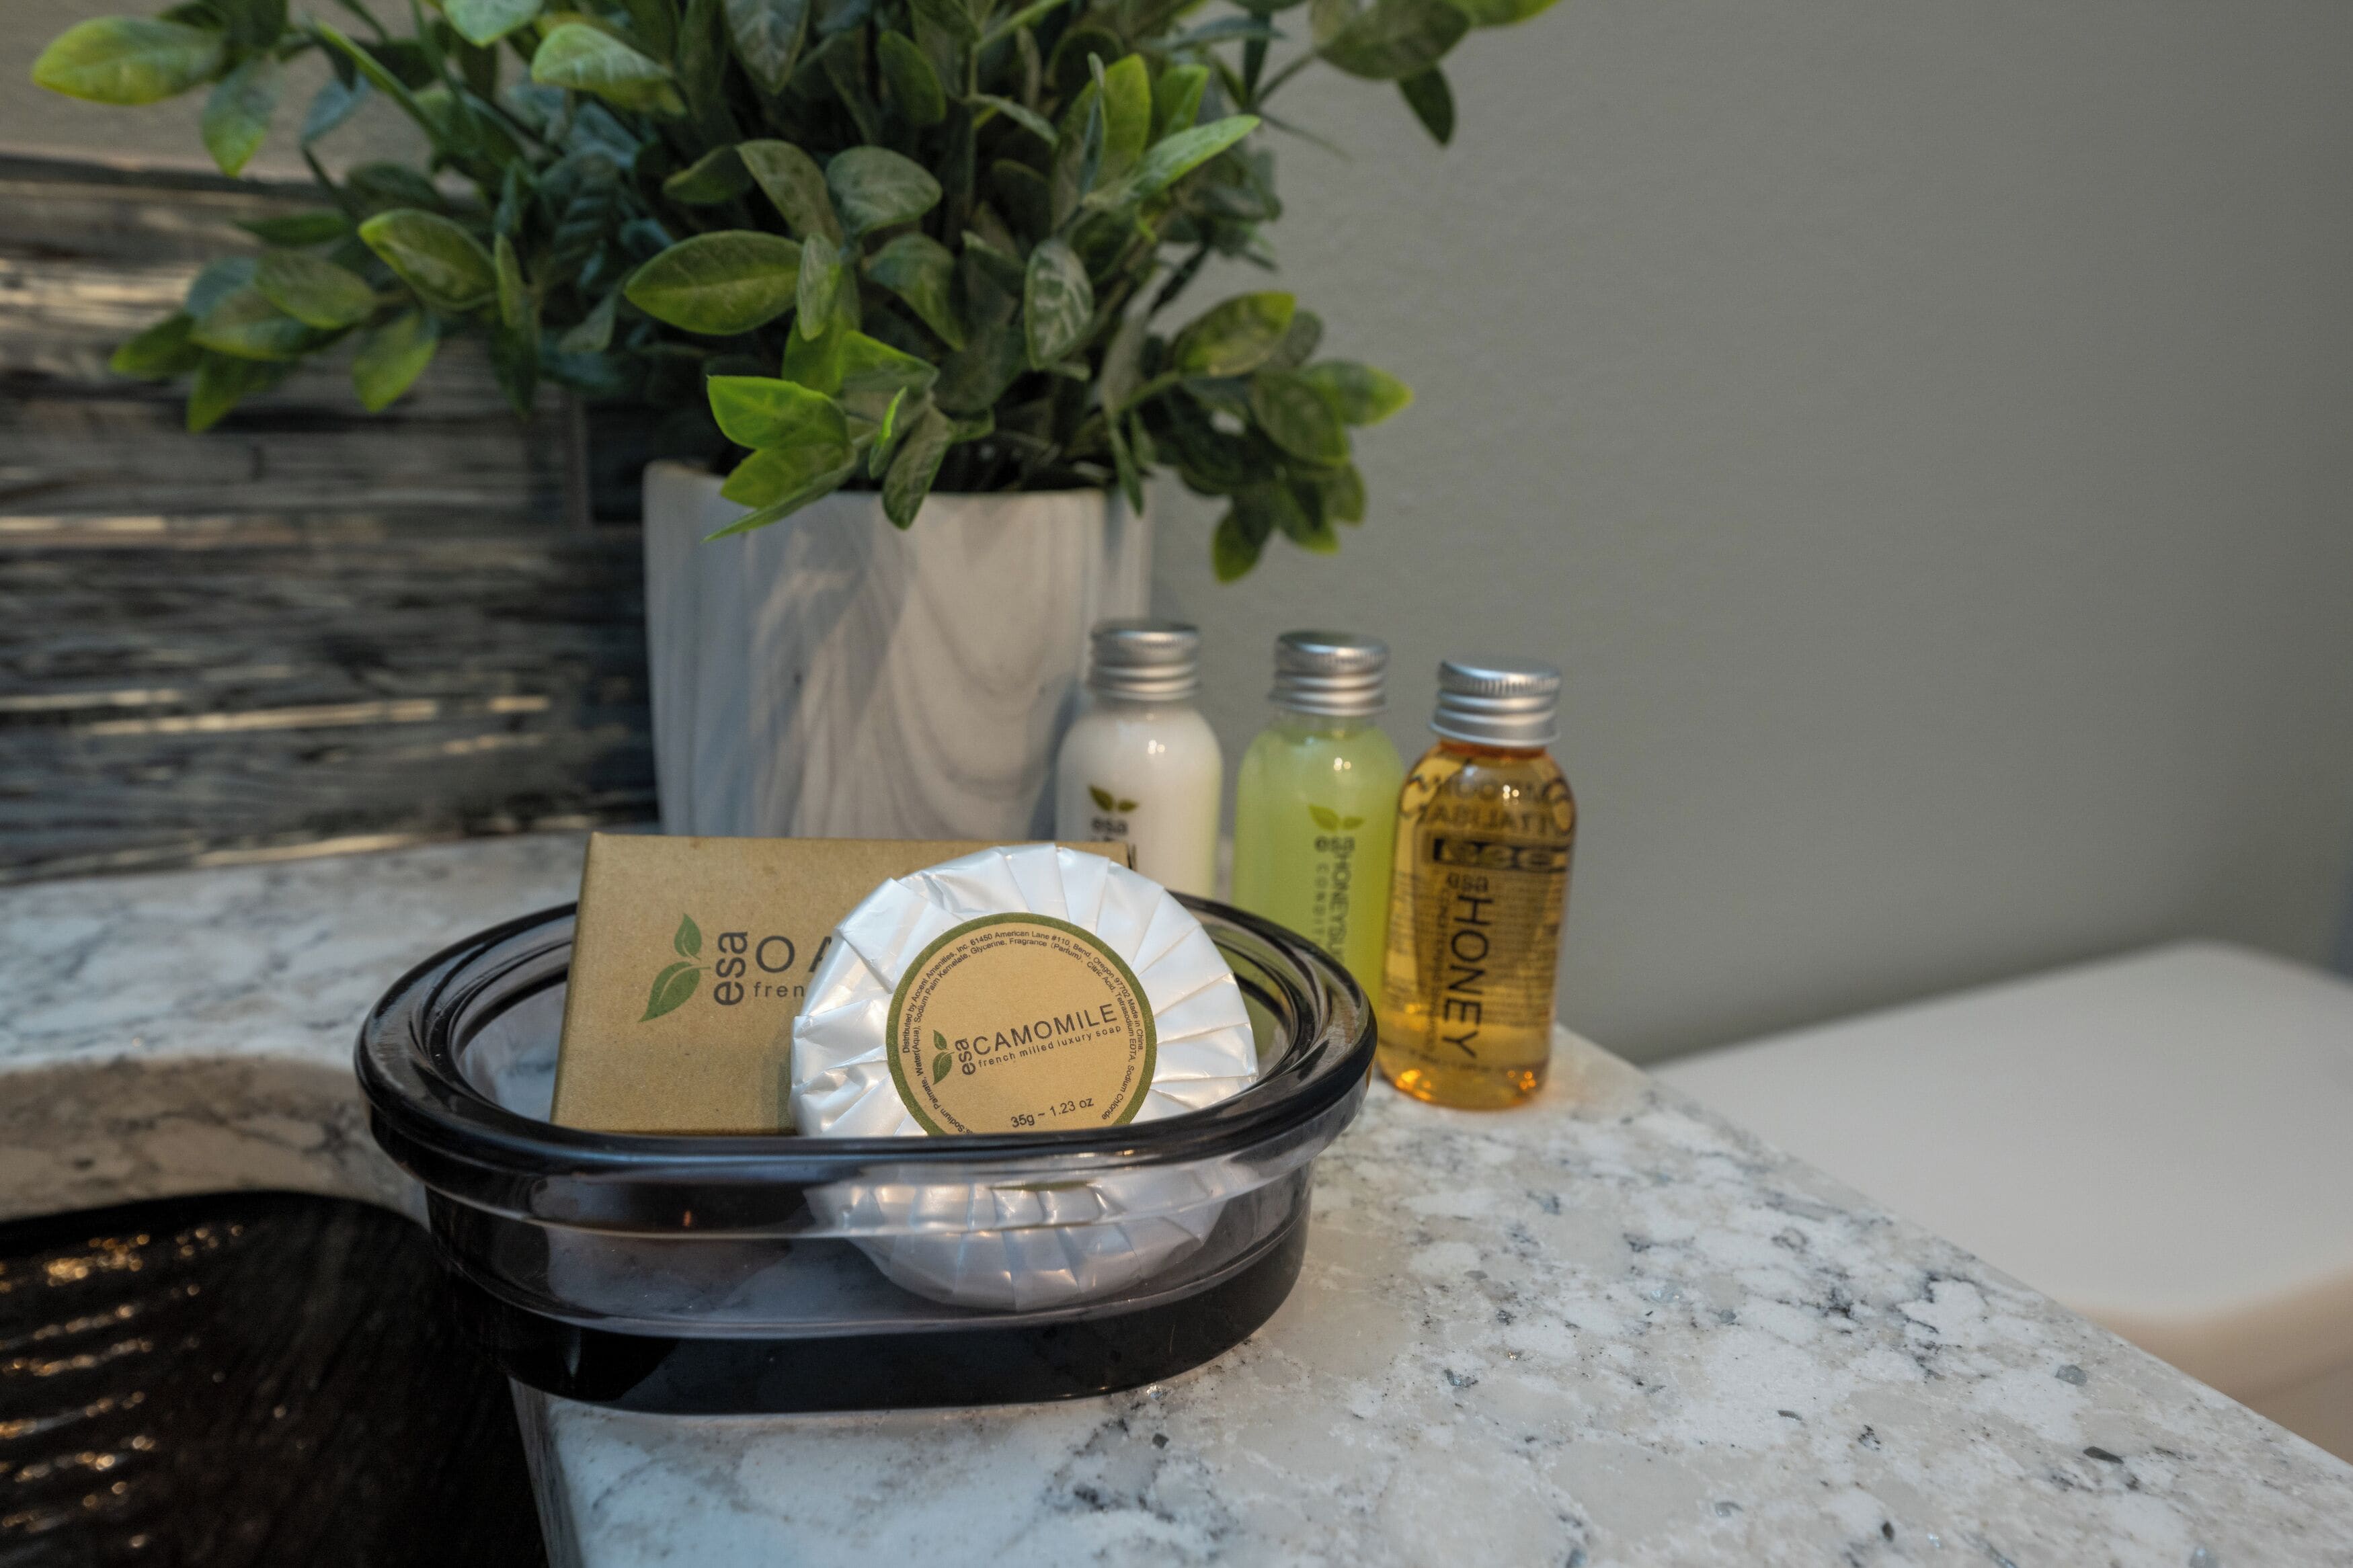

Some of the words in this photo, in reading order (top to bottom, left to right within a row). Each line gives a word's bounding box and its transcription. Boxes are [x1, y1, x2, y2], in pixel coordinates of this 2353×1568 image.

[970, 933, 993, 946] 61450
[995, 930, 1030, 938] American
[1009, 938, 1047, 946] Fragrance
[1032, 931, 1049, 940] Lane
[713, 932, 748, 1006] esa
[1086, 961, 1103, 977] Citric
[1093, 957, 1115, 979] Oregon
[1443, 895, 1493, 1058] HONEY
[912, 978, 929, 1003] Accent
[925, 978, 940, 995] Palm
[1114, 977, 1131, 998] 97702
[908, 1002, 917, 1013] by
[914, 995, 929, 1023] Sodium
[1115, 991, 1135, 1036] Tetrasodium
[1127, 999, 1138, 1020] Made
[902, 1014, 912, 1053] Distributed
[973, 1003, 1117, 1056] CAMOMILE
[955, 1038, 976, 1075] esa
[978, 1053, 1016, 1068] french
[1019, 1042, 1054, 1057] milled
[1057, 1032, 1092, 1048] luxury
[1096, 1026, 1121, 1037] soap
[1120, 1065, 1135, 1092] Sodium
[1010, 1114, 1035, 1128] 35g
[1049, 1100, 1076, 1116] 1.23
[1079, 1098, 1094, 1108] oz
[1101, 1094, 1124, 1120] Chloride
